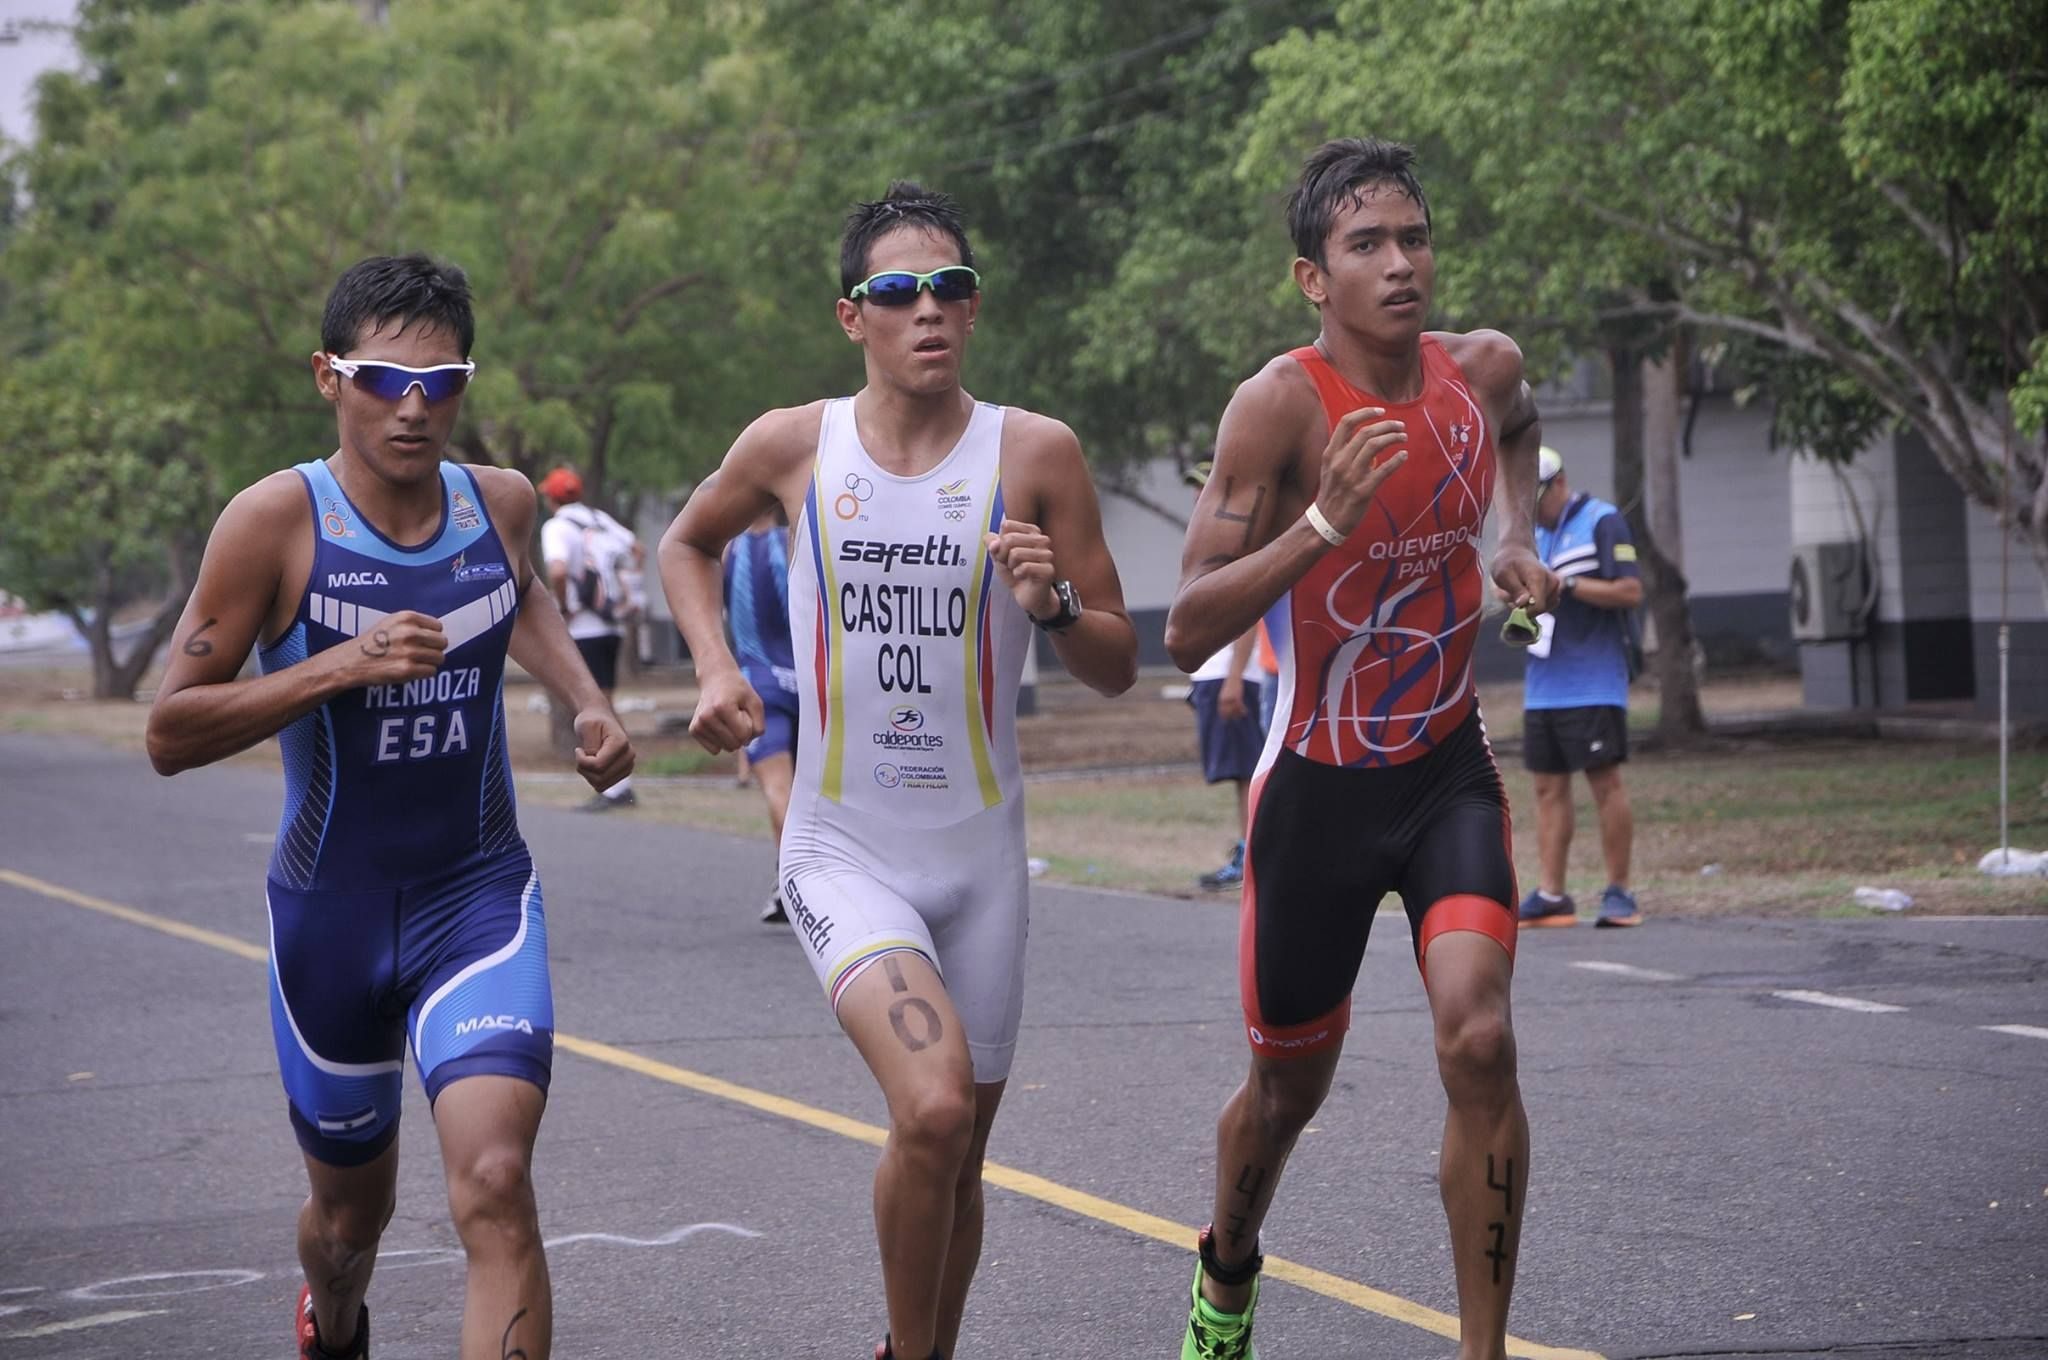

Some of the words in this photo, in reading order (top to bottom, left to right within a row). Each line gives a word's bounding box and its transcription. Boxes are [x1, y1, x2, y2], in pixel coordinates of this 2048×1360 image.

[1369, 525, 1469, 559] QUEVEDO
[327, 572, 389, 588] MACA
[1398, 554, 1441, 580] PAN
[840, 582, 967, 638] CASTILLO
[183, 617, 219, 658] 6
[877, 643, 932, 694] COL
[365, 666, 481, 709] MENDOZA
[377, 709, 468, 762] ESA
[873, 730, 943, 747] coldeportes
[455, 1014, 534, 1036] MACA
